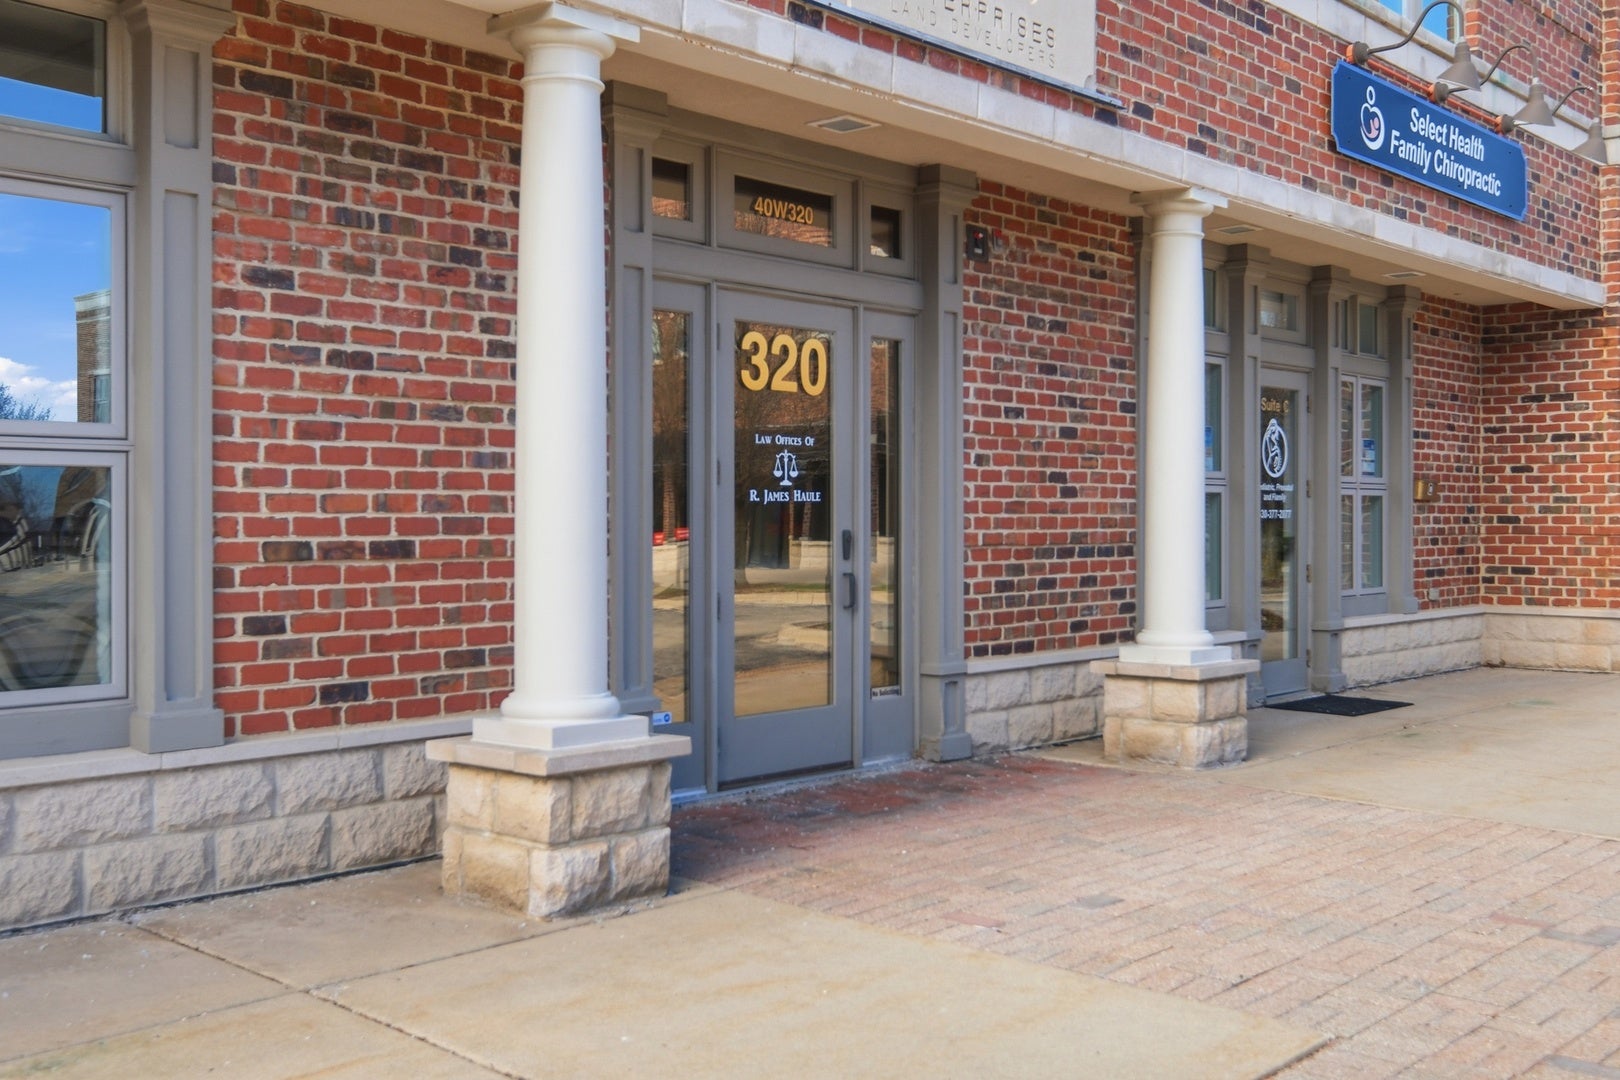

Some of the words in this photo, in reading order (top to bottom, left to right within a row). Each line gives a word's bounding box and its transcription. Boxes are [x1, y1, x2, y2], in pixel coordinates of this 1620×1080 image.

[890, 0, 937, 26] LAND
[951, 18, 1055, 69] DEVELOPERS
[932, 0, 1055, 48] ERPRISES
[1409, 107, 1448, 146] Select
[1448, 125, 1485, 162] Health
[1390, 129, 1432, 174] Family
[1433, 149, 1502, 196] Chiropractic
[754, 196, 815, 225] 40W320
[740, 331, 828, 397] 320
[1260, 397, 1281, 413] Suite
[749, 489, 760, 502] R.
